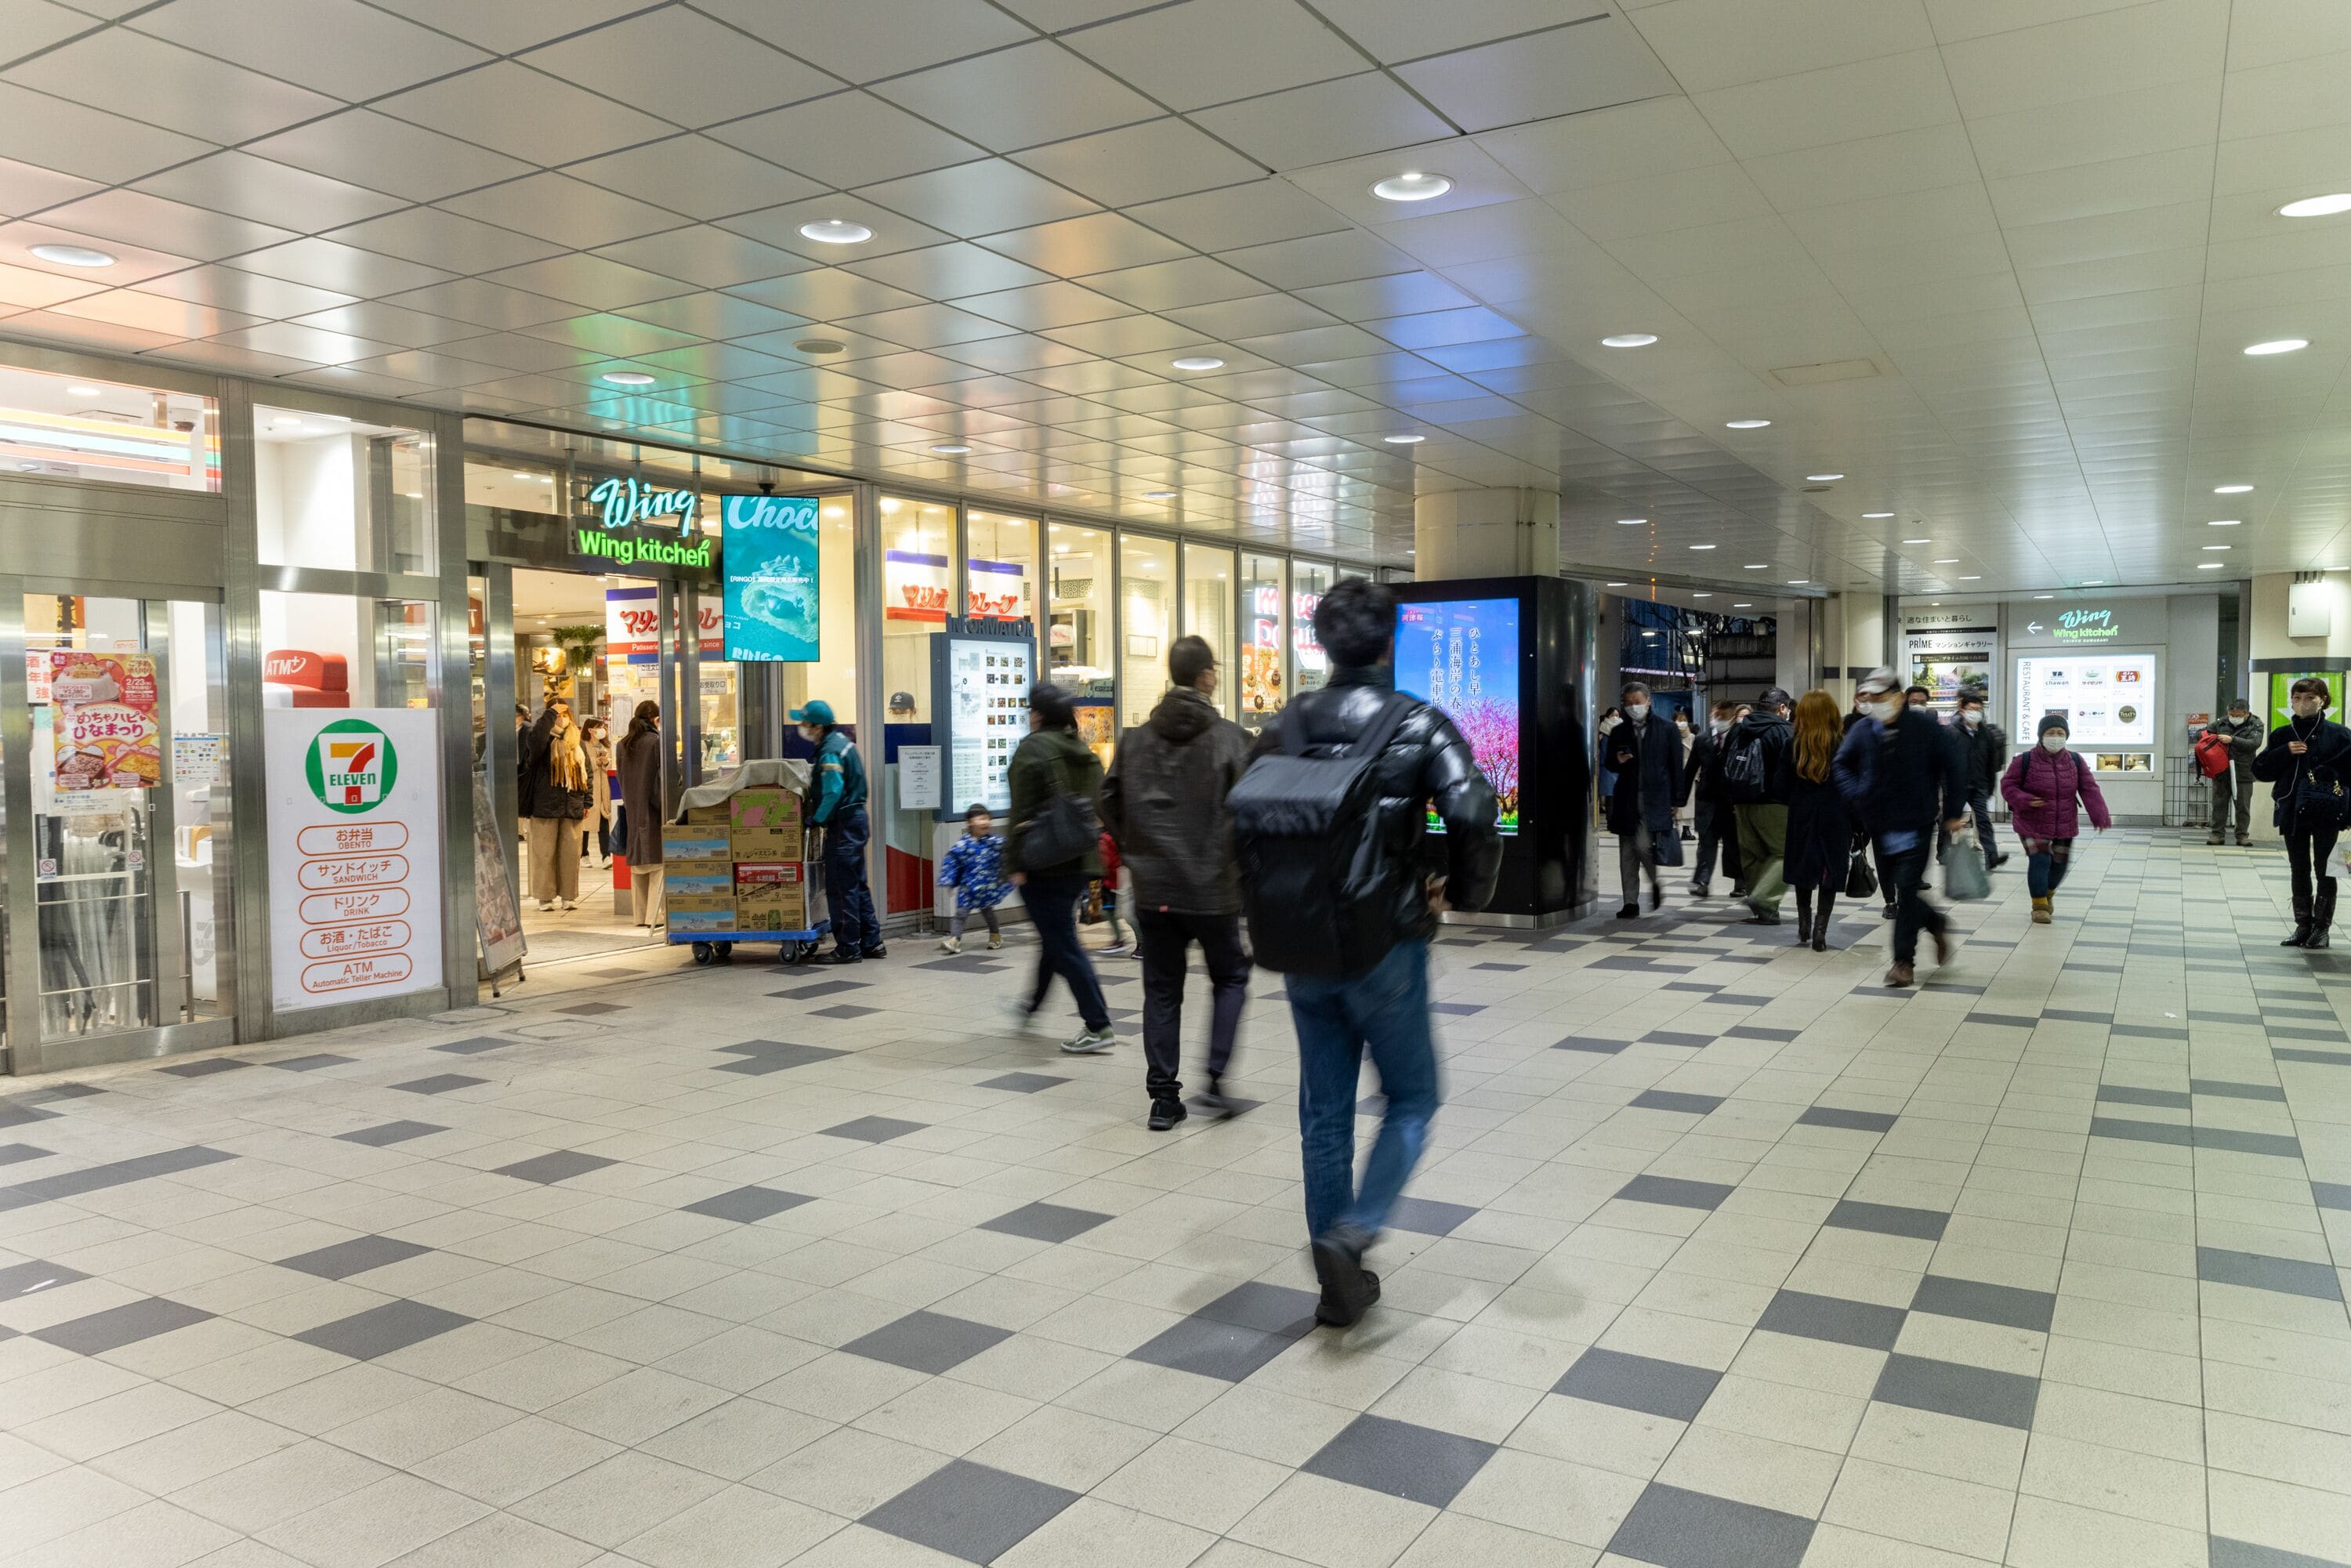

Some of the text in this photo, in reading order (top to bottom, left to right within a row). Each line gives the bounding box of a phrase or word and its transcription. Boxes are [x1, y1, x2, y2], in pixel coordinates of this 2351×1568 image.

[590, 477, 697, 537] Wing
[578, 530, 711, 567] Wing kitchen
[2059, 610, 2111, 628] Wing
[2053, 625, 2118, 639] Wing kitchen
[1909, 638, 1933, 649] PRIME
[266, 659, 292, 675] ATM
[1469, 628, 1480, 707] ひとあし早い
[2023, 661, 2031, 712] RESTAURANT
[77, 711, 140, 724] めちゃハピ
[74, 723, 143, 740] ひなまつり
[330, 742, 375, 805] 7
[336, 828, 373, 841] お弁当
[339, 841, 371, 849] OBENTO
[317, 860, 391, 877] サンドイッチ
[333, 874, 378, 884] SANDWICH
[335, 894, 380, 910] ドリンク
[320, 927, 393, 944] お酒・たばこ
[327, 940, 387, 953] Liquor/Tobacco
[343, 962, 373, 976] ATM
[313, 969, 403, 989] Automatic Teller Machine
